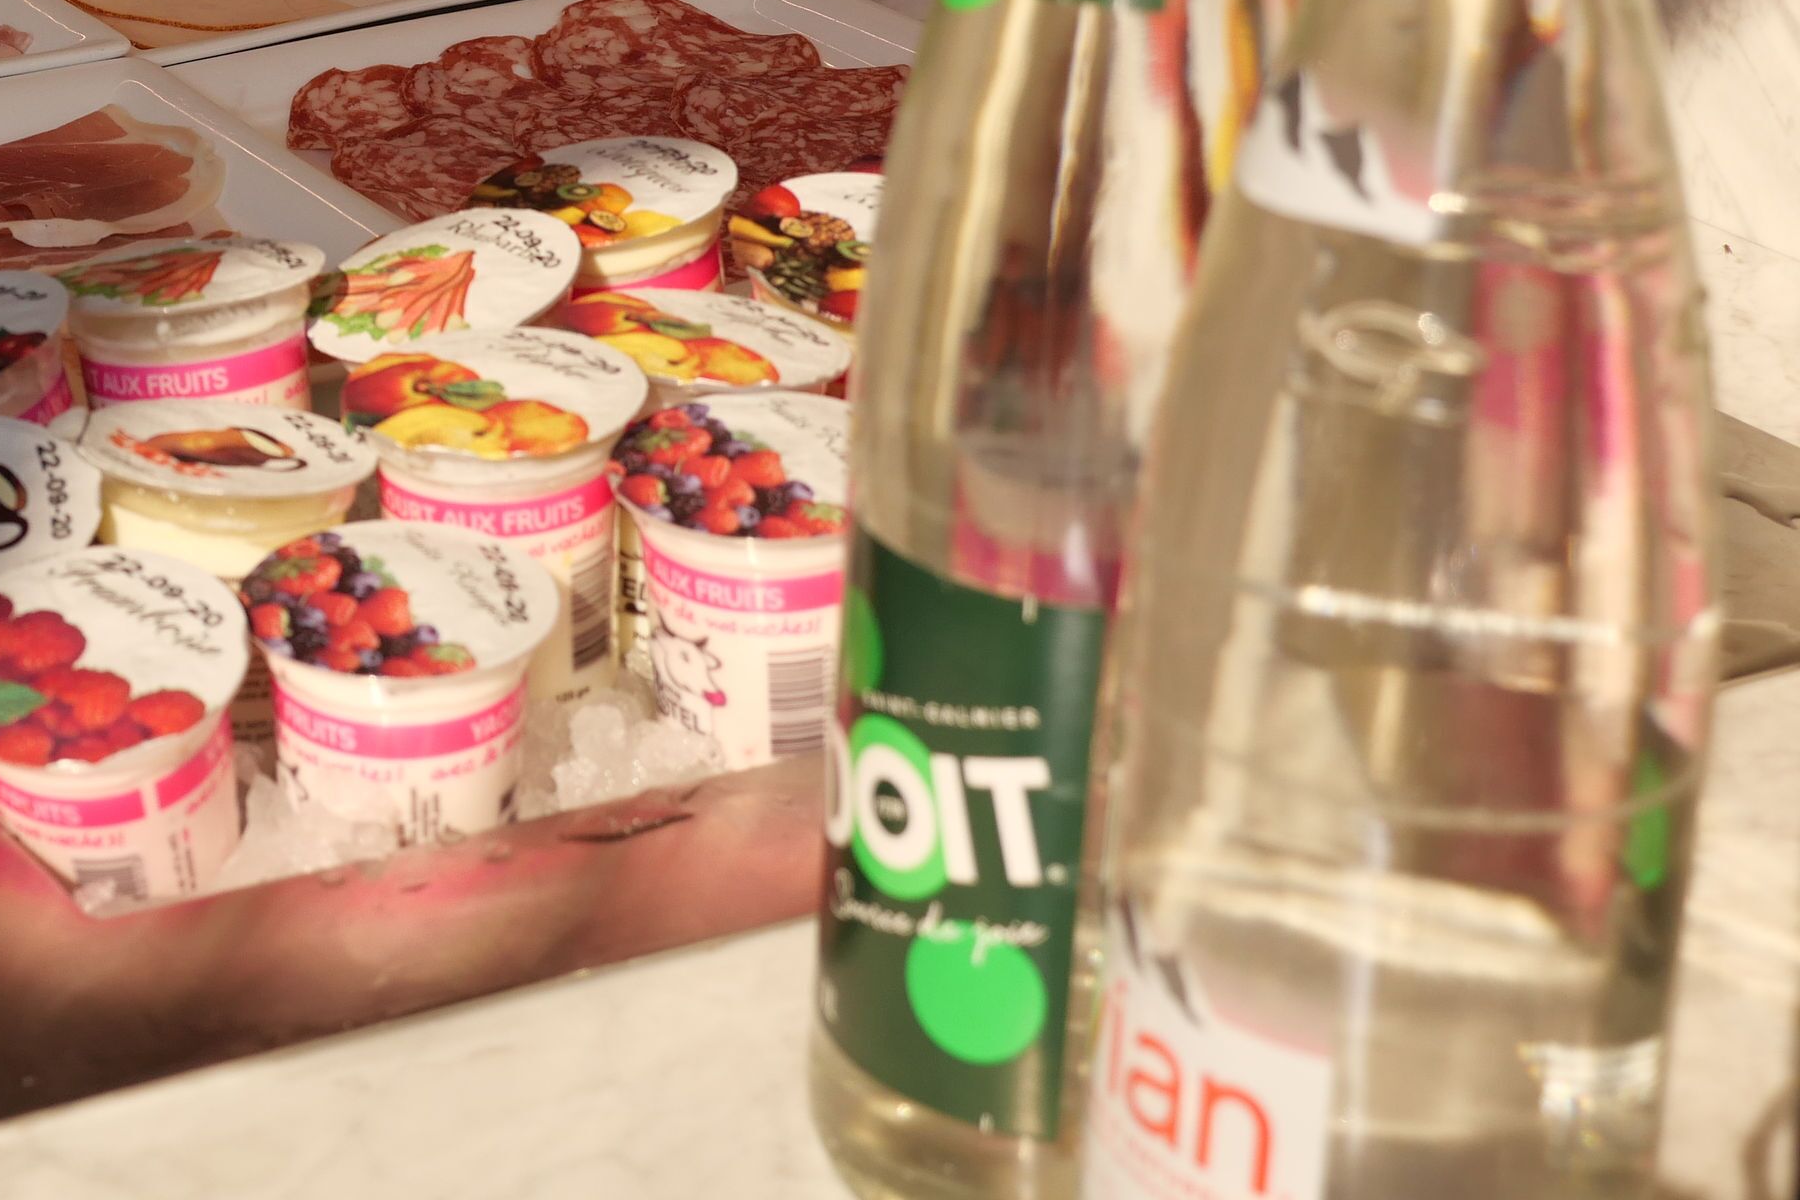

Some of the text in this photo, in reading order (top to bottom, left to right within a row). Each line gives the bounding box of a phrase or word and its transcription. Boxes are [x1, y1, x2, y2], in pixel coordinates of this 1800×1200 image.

[103, 371, 143, 397] AUX
[148, 365, 230, 397] FRUITS
[502, 496, 586, 535] FRUITS
[694, 579, 786, 612] FRUITS
